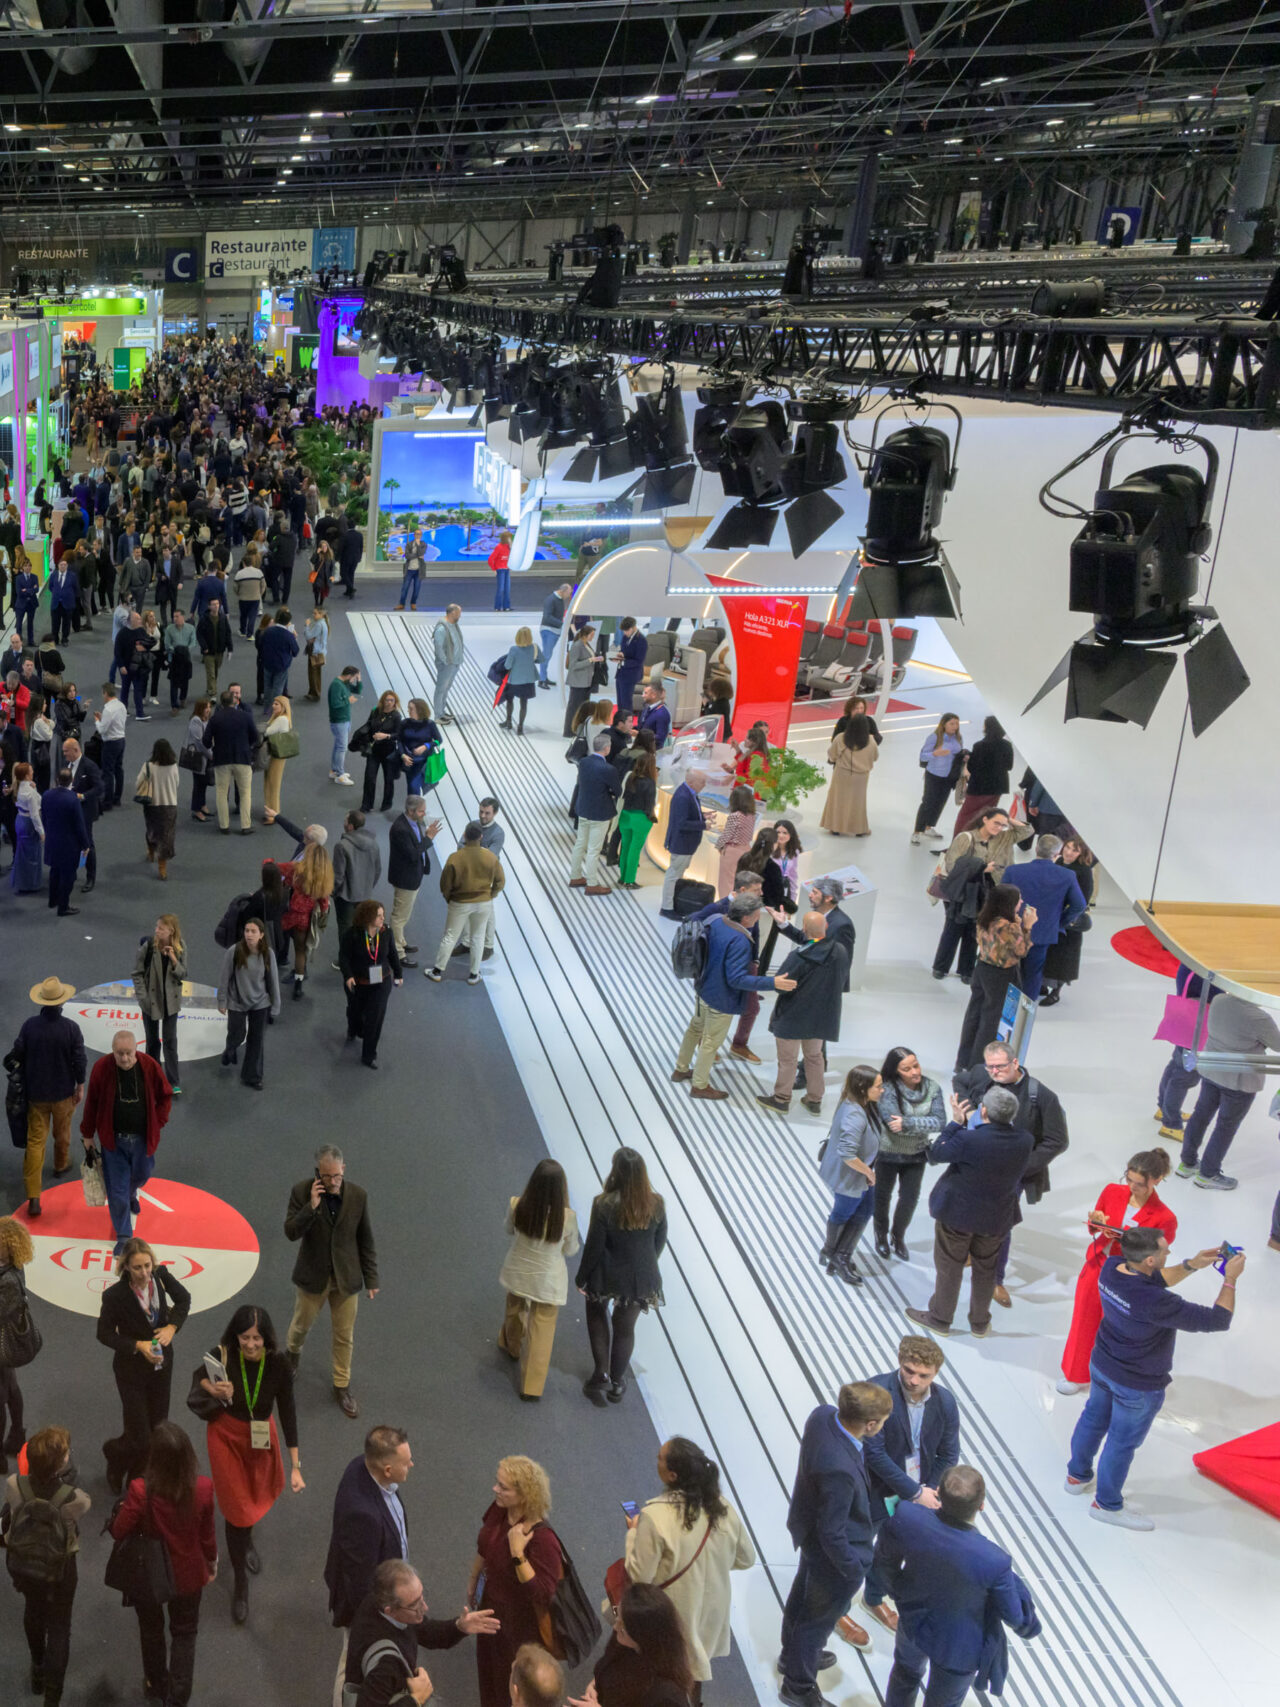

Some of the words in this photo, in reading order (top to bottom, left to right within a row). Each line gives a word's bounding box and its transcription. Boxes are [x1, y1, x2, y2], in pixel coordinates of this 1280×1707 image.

[211, 239, 307, 254] Restaurante
[19, 248, 89, 259] RESTAURANTE
[172, 253, 191, 278] C
[212, 264, 221, 276] C
[745, 611, 759, 622] Hola
[760, 614, 775, 626] A321
[96, 1008, 143, 1020] Fitu
